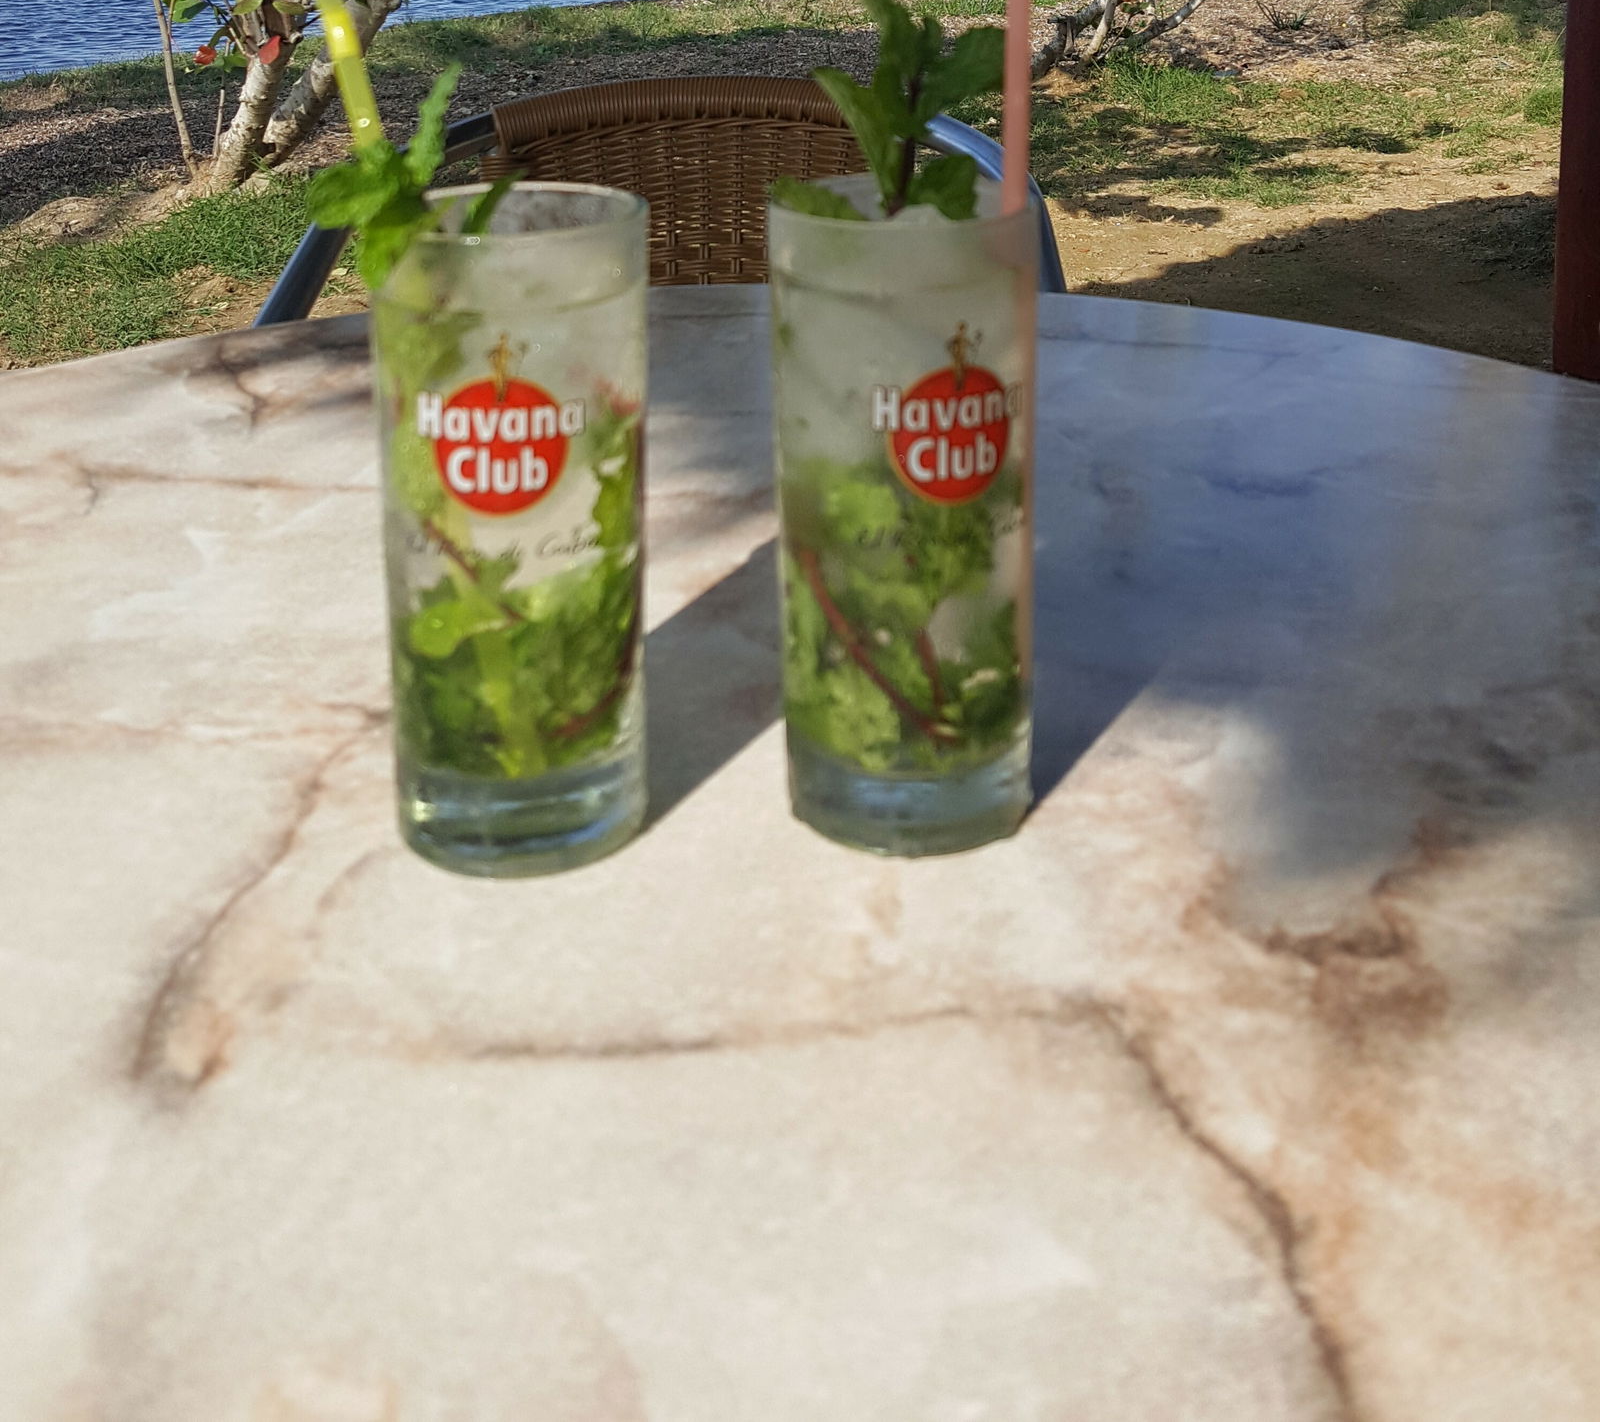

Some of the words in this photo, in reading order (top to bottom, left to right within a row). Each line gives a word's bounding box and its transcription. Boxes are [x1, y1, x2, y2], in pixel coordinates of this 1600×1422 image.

[417, 391, 586, 443] Havana
[872, 383, 1023, 432] Havana
[446, 445, 549, 494] Club
[905, 432, 998, 482] Club
